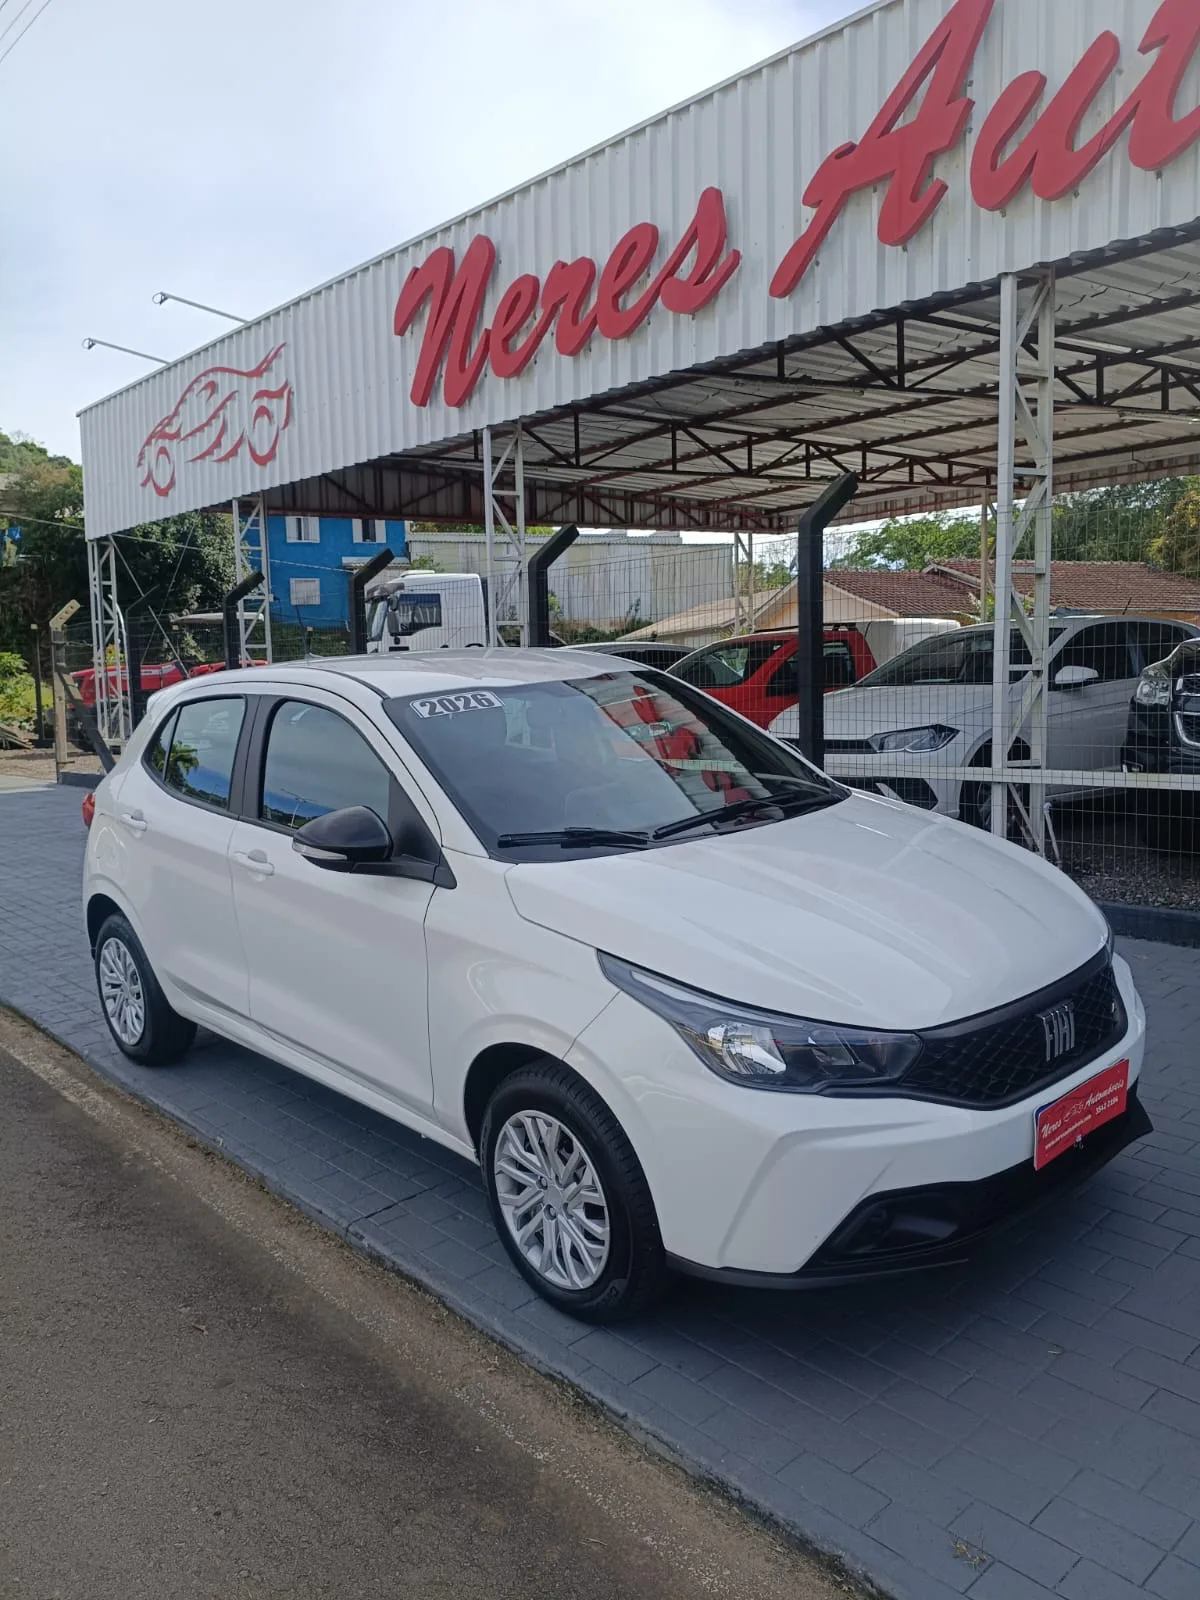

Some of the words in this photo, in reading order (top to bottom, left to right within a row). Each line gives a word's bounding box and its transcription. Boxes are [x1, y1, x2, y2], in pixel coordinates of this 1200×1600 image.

[394, 187, 742, 408] Neres
[419, 693, 495, 716] 2026
[1041, 1005, 1074, 1061] FIAT
